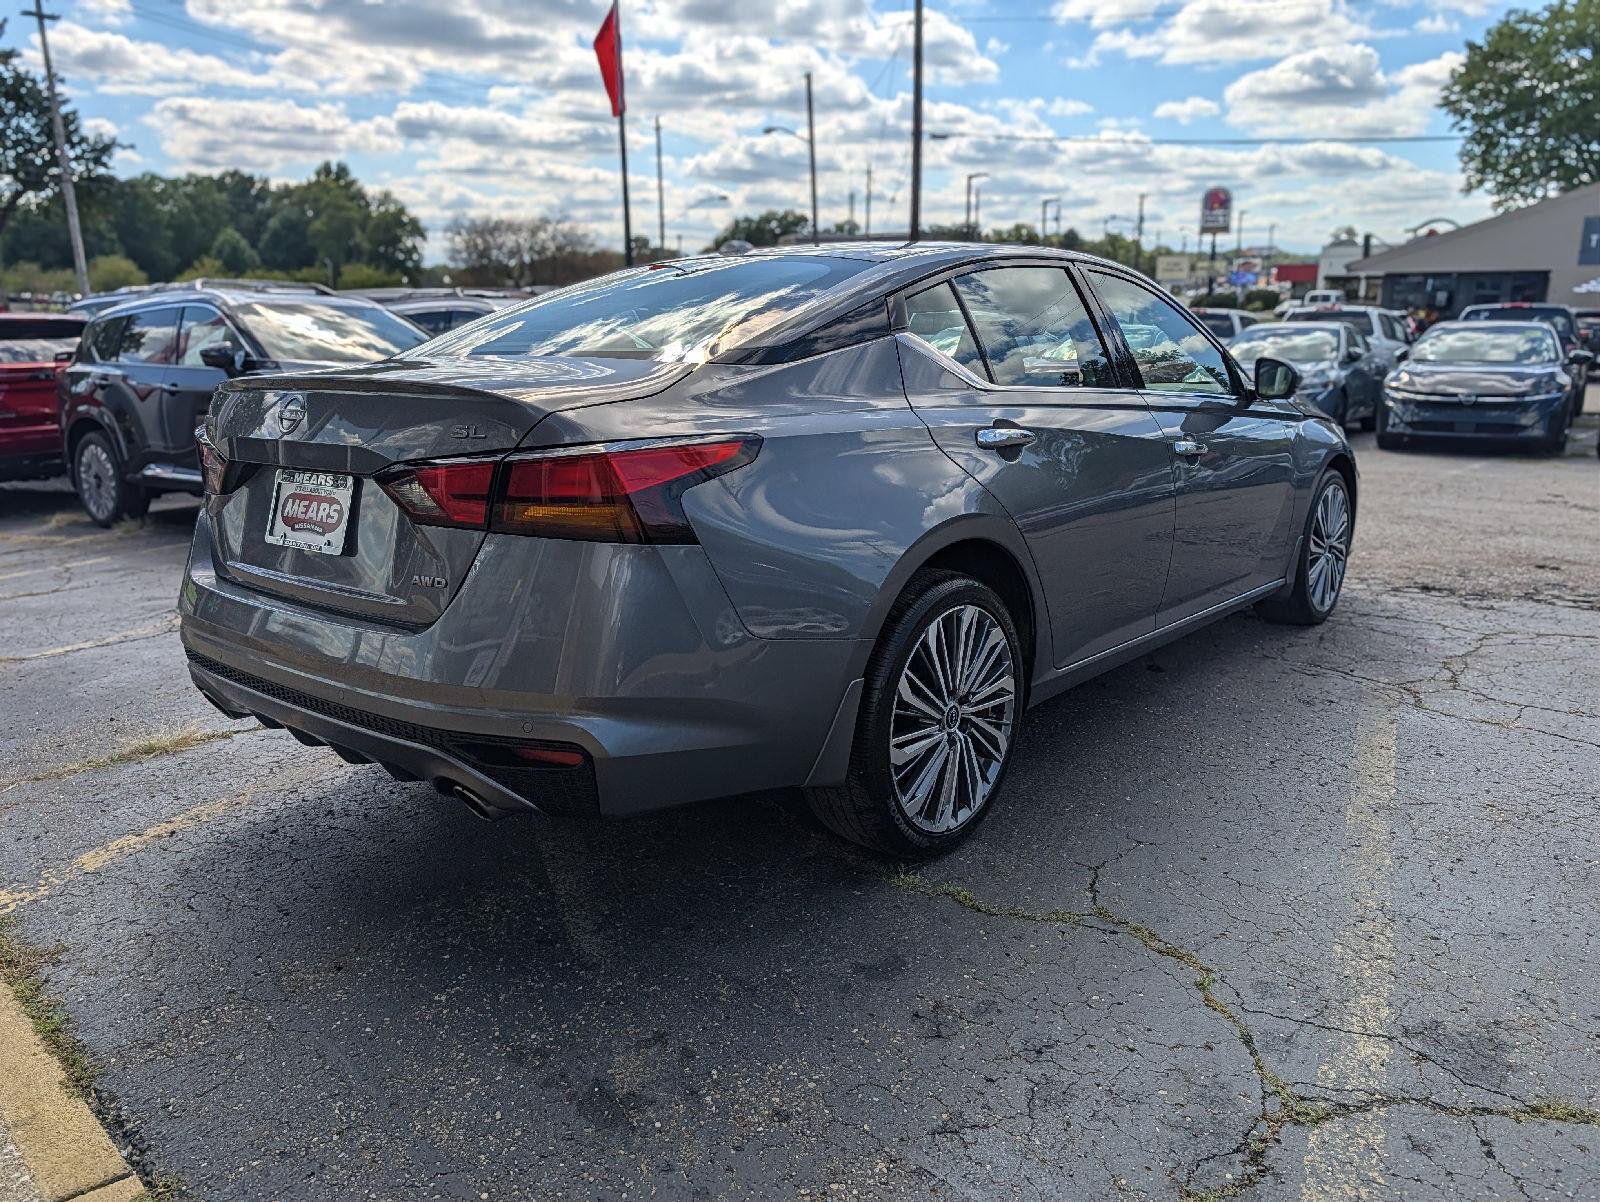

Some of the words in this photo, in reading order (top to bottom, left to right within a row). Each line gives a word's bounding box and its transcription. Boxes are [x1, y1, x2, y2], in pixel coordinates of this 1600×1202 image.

[451, 424, 487, 439] SL
[294, 472, 334, 486] MEARS
[283, 498, 340, 524] MEARS
[411, 575, 448, 588] AWD
